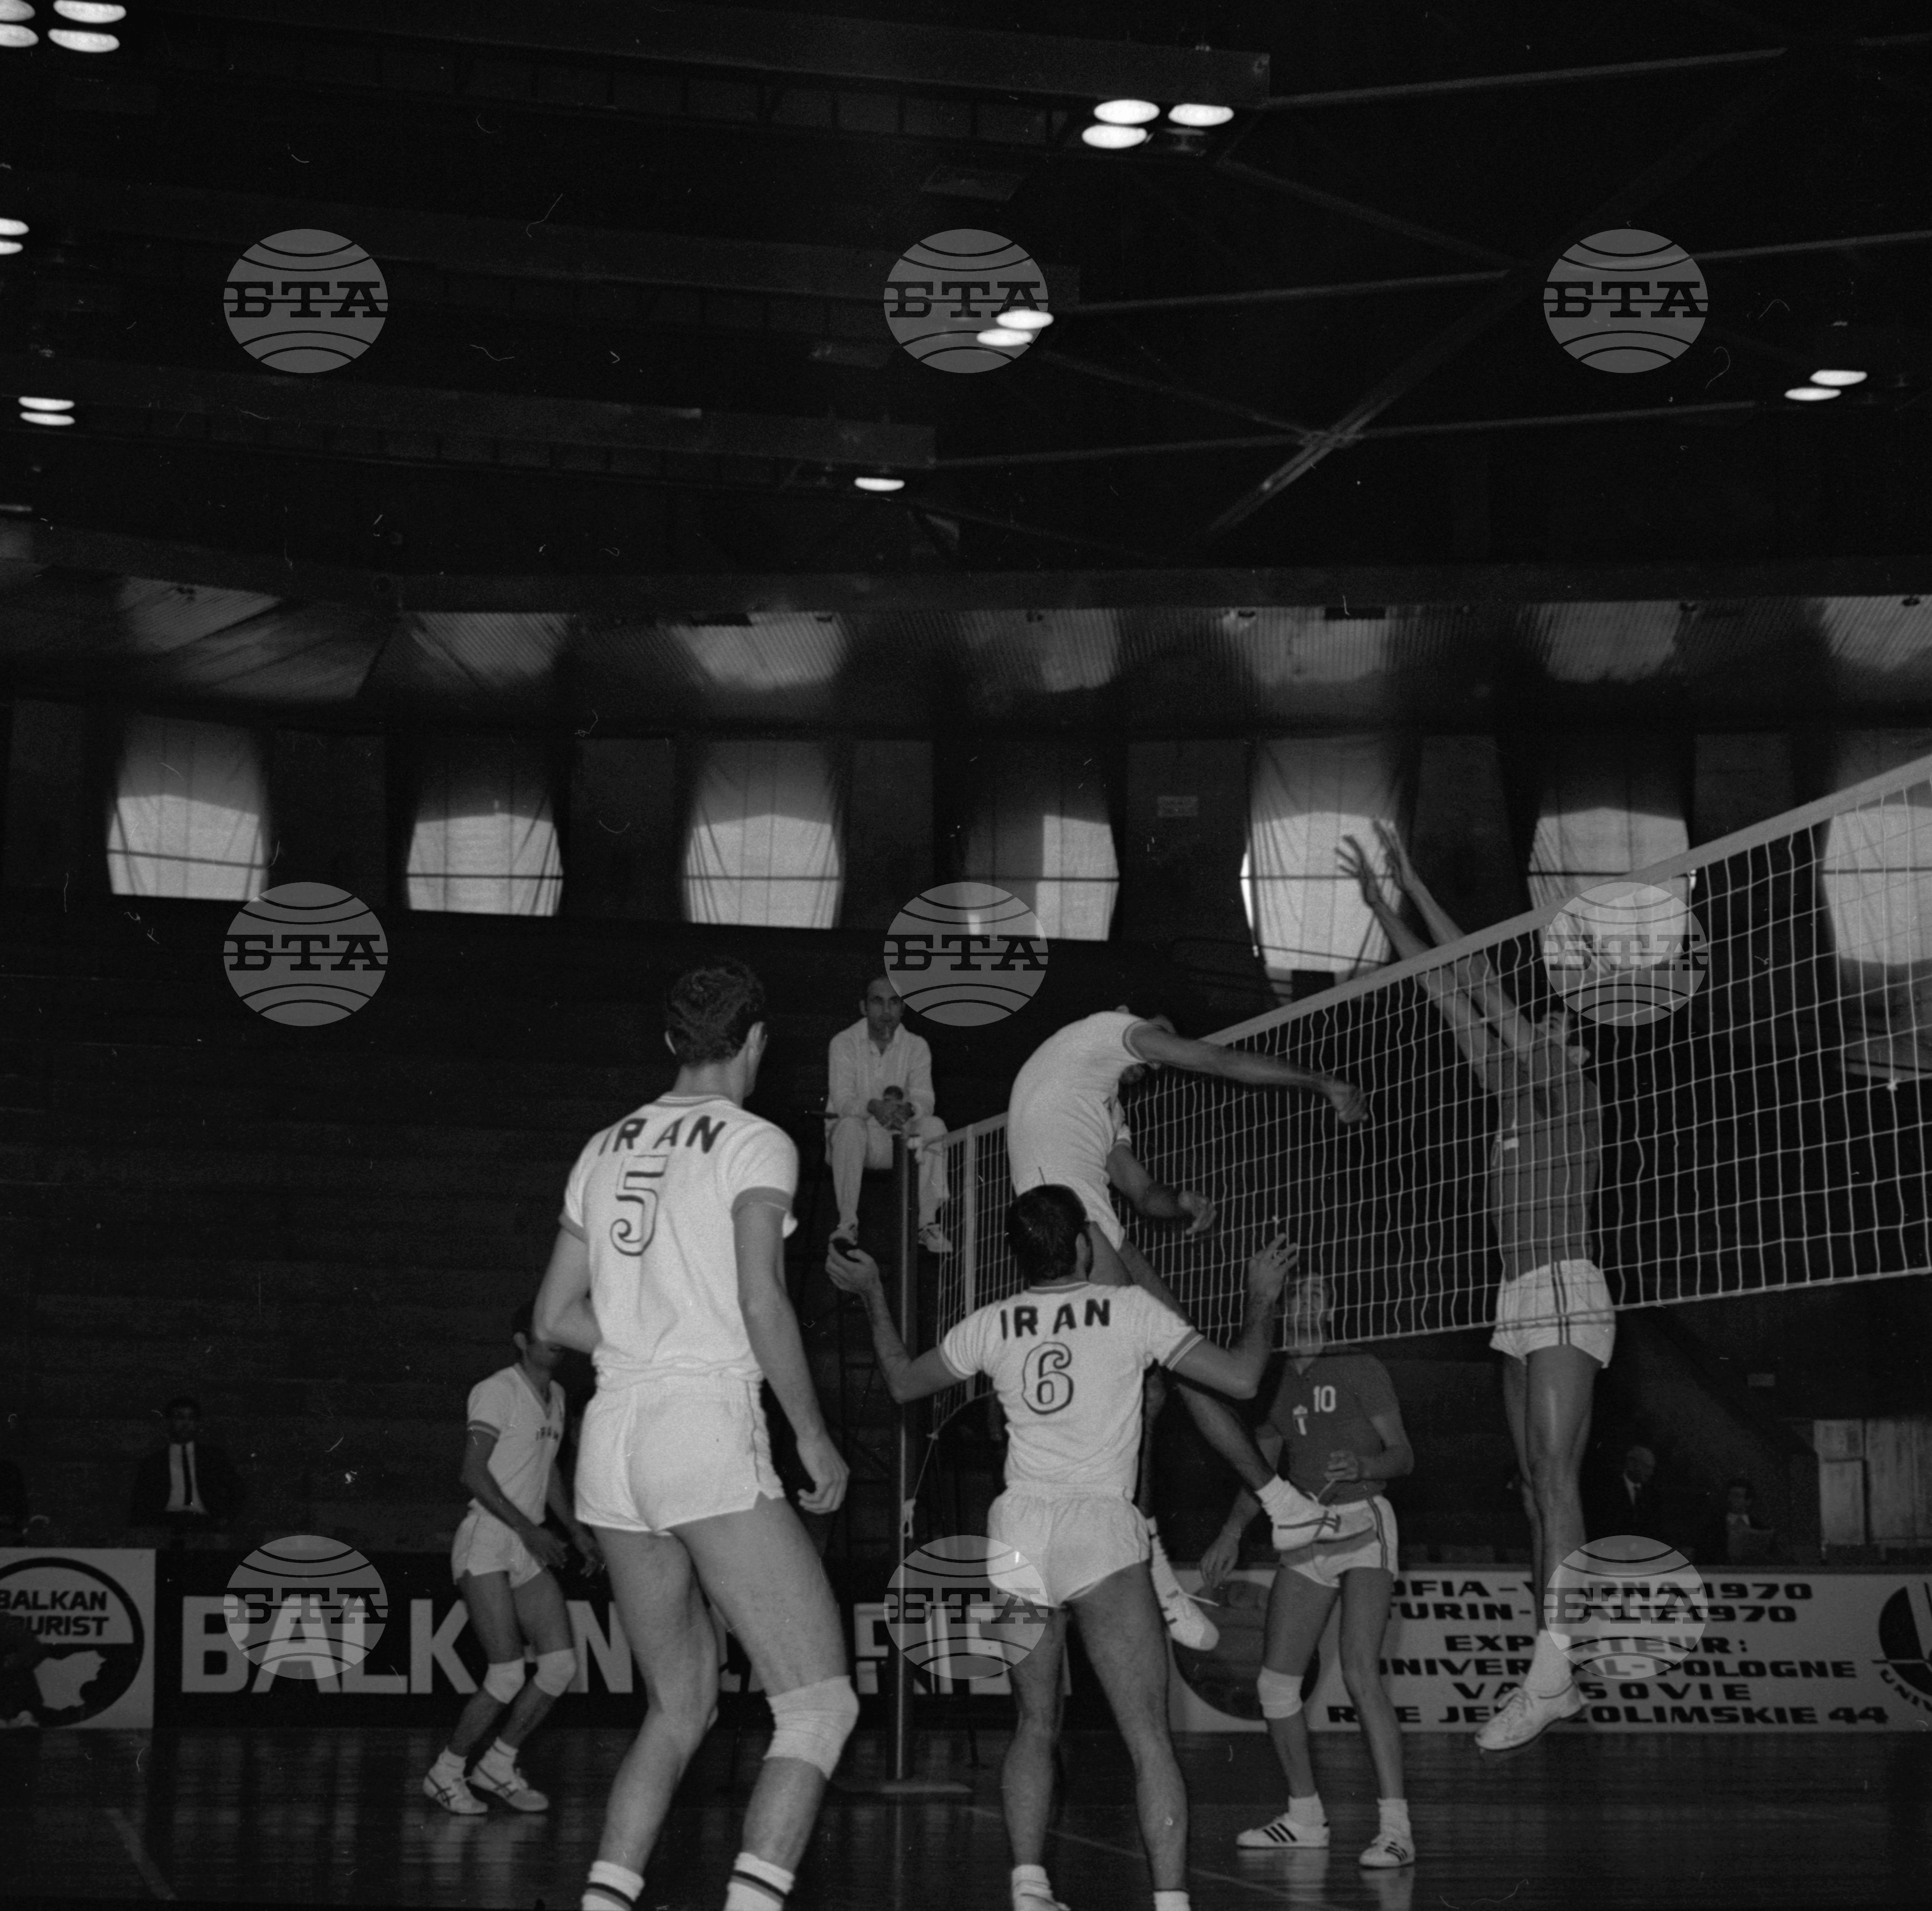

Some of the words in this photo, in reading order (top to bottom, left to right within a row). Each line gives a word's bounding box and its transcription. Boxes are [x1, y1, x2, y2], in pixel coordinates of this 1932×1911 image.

[598, 1115, 726, 1155] IRAN
[610, 1155, 669, 1256] 5
[1000, 1298, 1110, 1341] IRAN
[1022, 1341, 1074, 1415] 6
[1313, 1385, 1336, 1412] 10
[0, 1589, 107, 1611] BALKAN
[182, 1596, 634, 1694] BALKN
[1445, 1635, 1747, 1654] EXPRTEUR:
[1328, 1706, 1421, 1724] RE
[1828, 1706, 1889, 1725] 44
